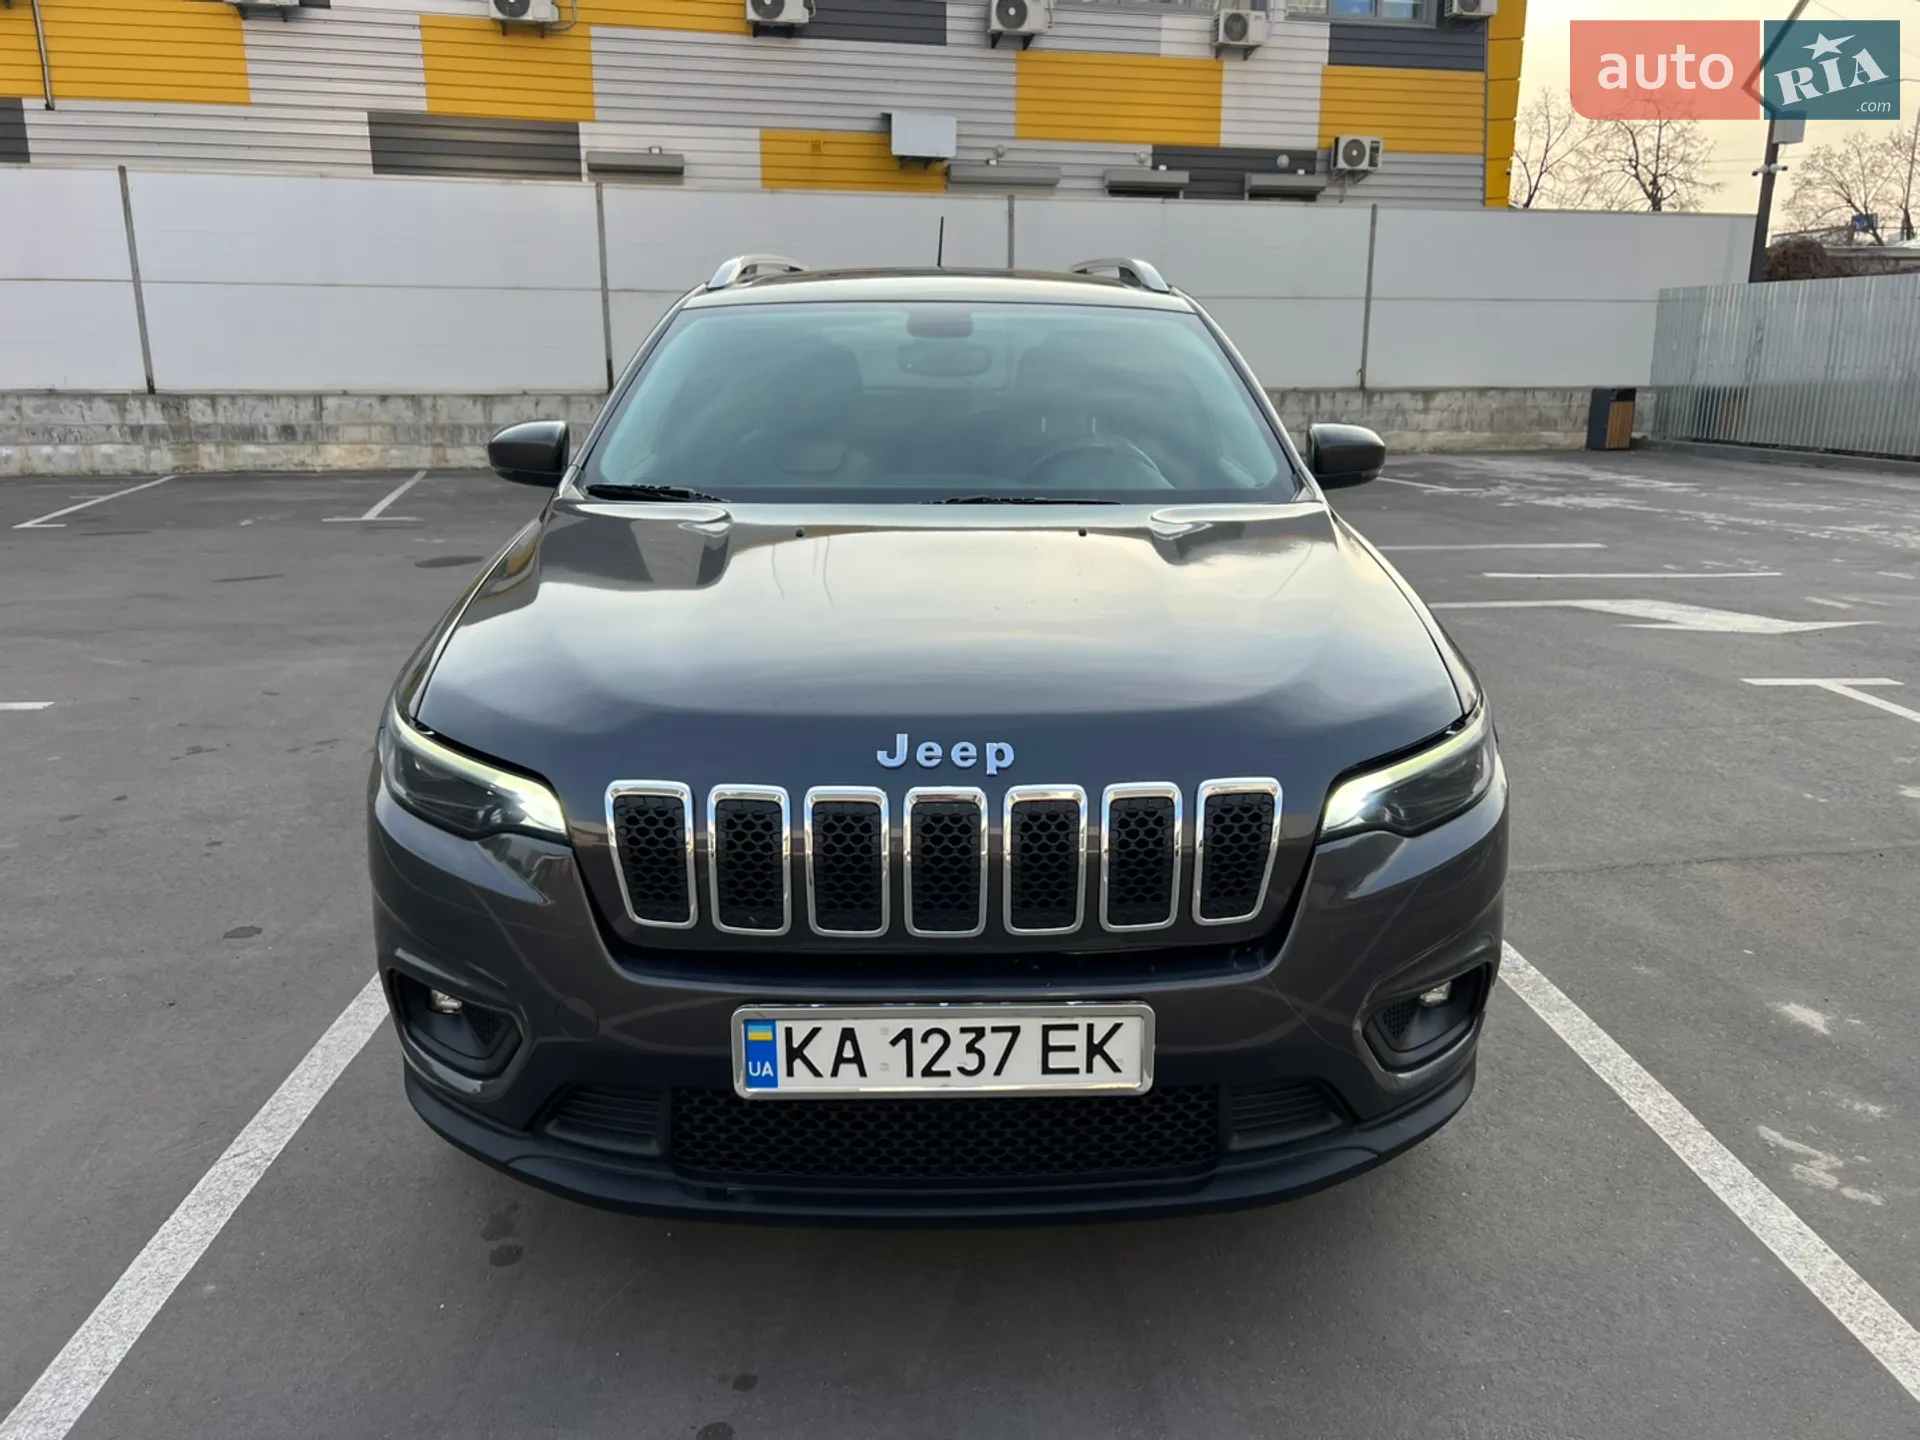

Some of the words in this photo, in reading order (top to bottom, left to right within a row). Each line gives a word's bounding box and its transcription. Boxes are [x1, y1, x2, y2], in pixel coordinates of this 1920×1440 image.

[876, 733, 1015, 776] Jeep
[748, 1061, 774, 1078] UA
[784, 1027, 868, 1078] KA
[888, 1025, 1022, 1078] 1237
[1041, 1022, 1125, 1076] EK
